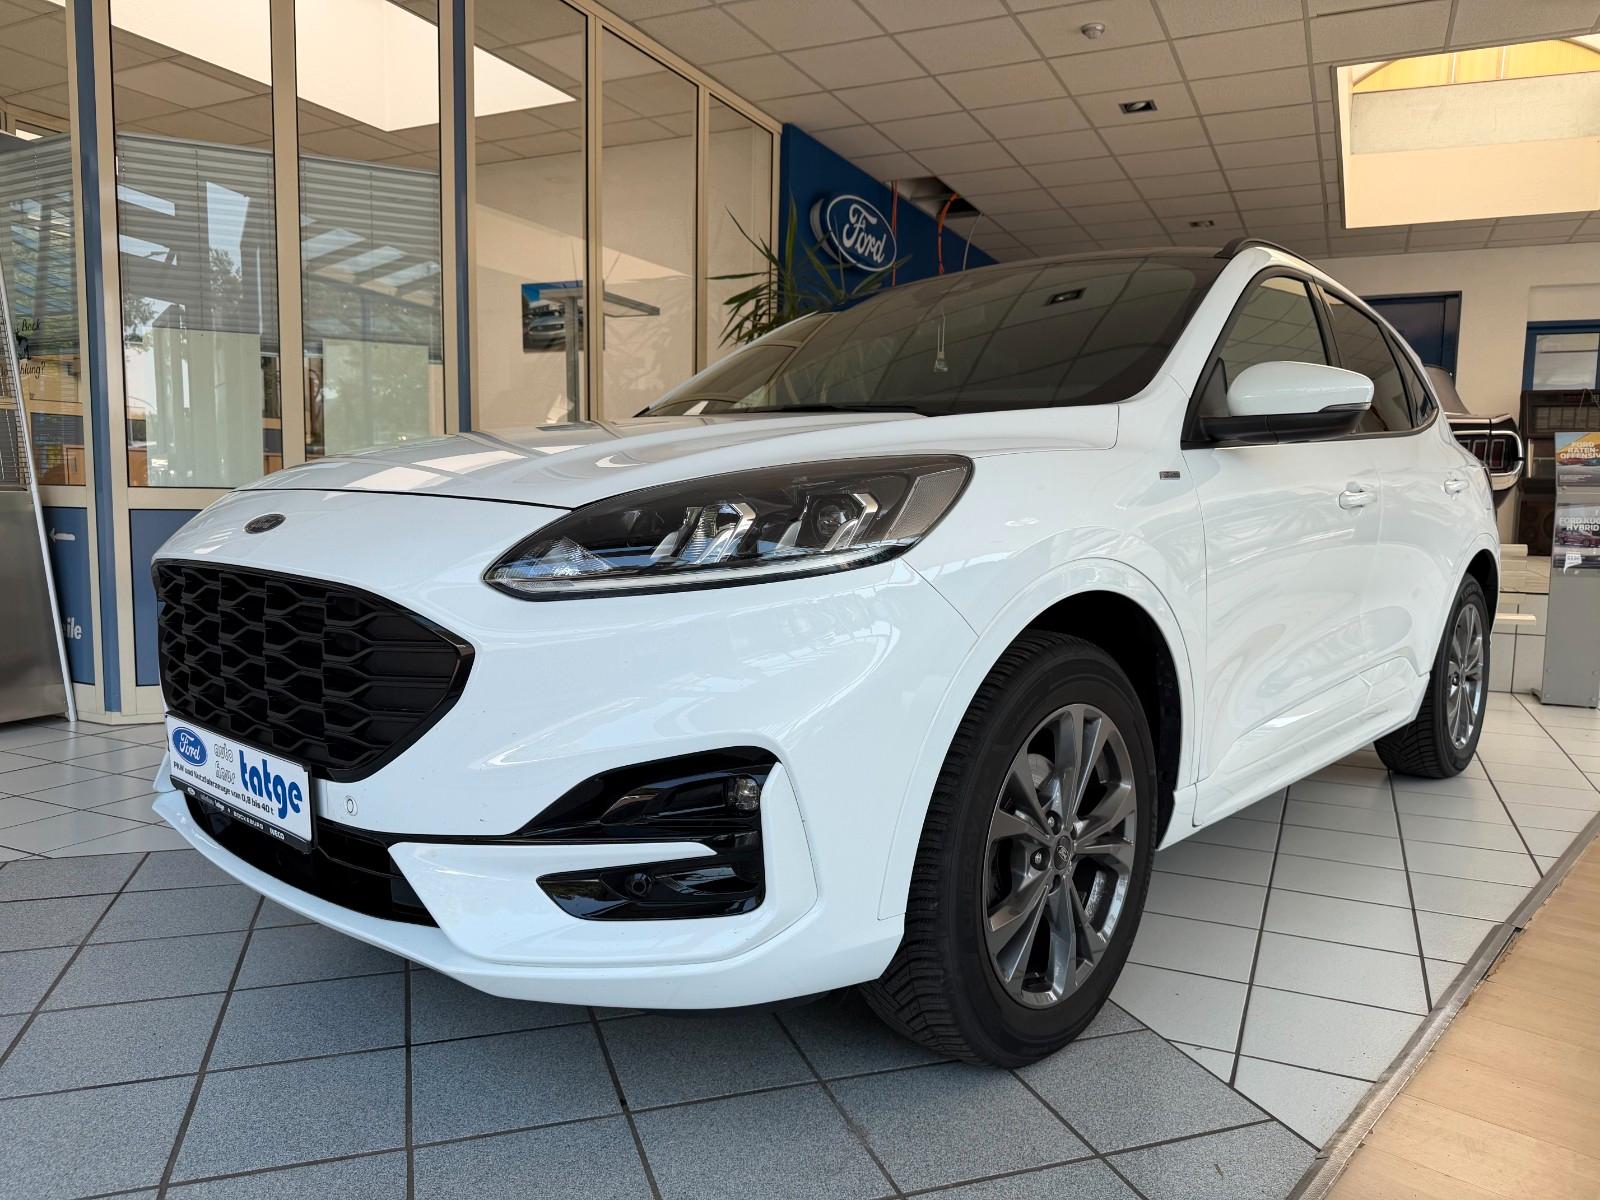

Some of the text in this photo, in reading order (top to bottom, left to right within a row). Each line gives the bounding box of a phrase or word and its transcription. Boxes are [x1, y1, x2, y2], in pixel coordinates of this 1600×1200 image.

[843, 204, 886, 263] Ford
[66, 617, 82, 639] ile
[180, 733, 201, 760] Ford
[214, 743, 302, 819] auto tatge
[231, 790, 241, 800] von
[241, 793, 252, 805] 0,8
[252, 799, 261, 809] bis
[262, 803, 270, 813] 40
